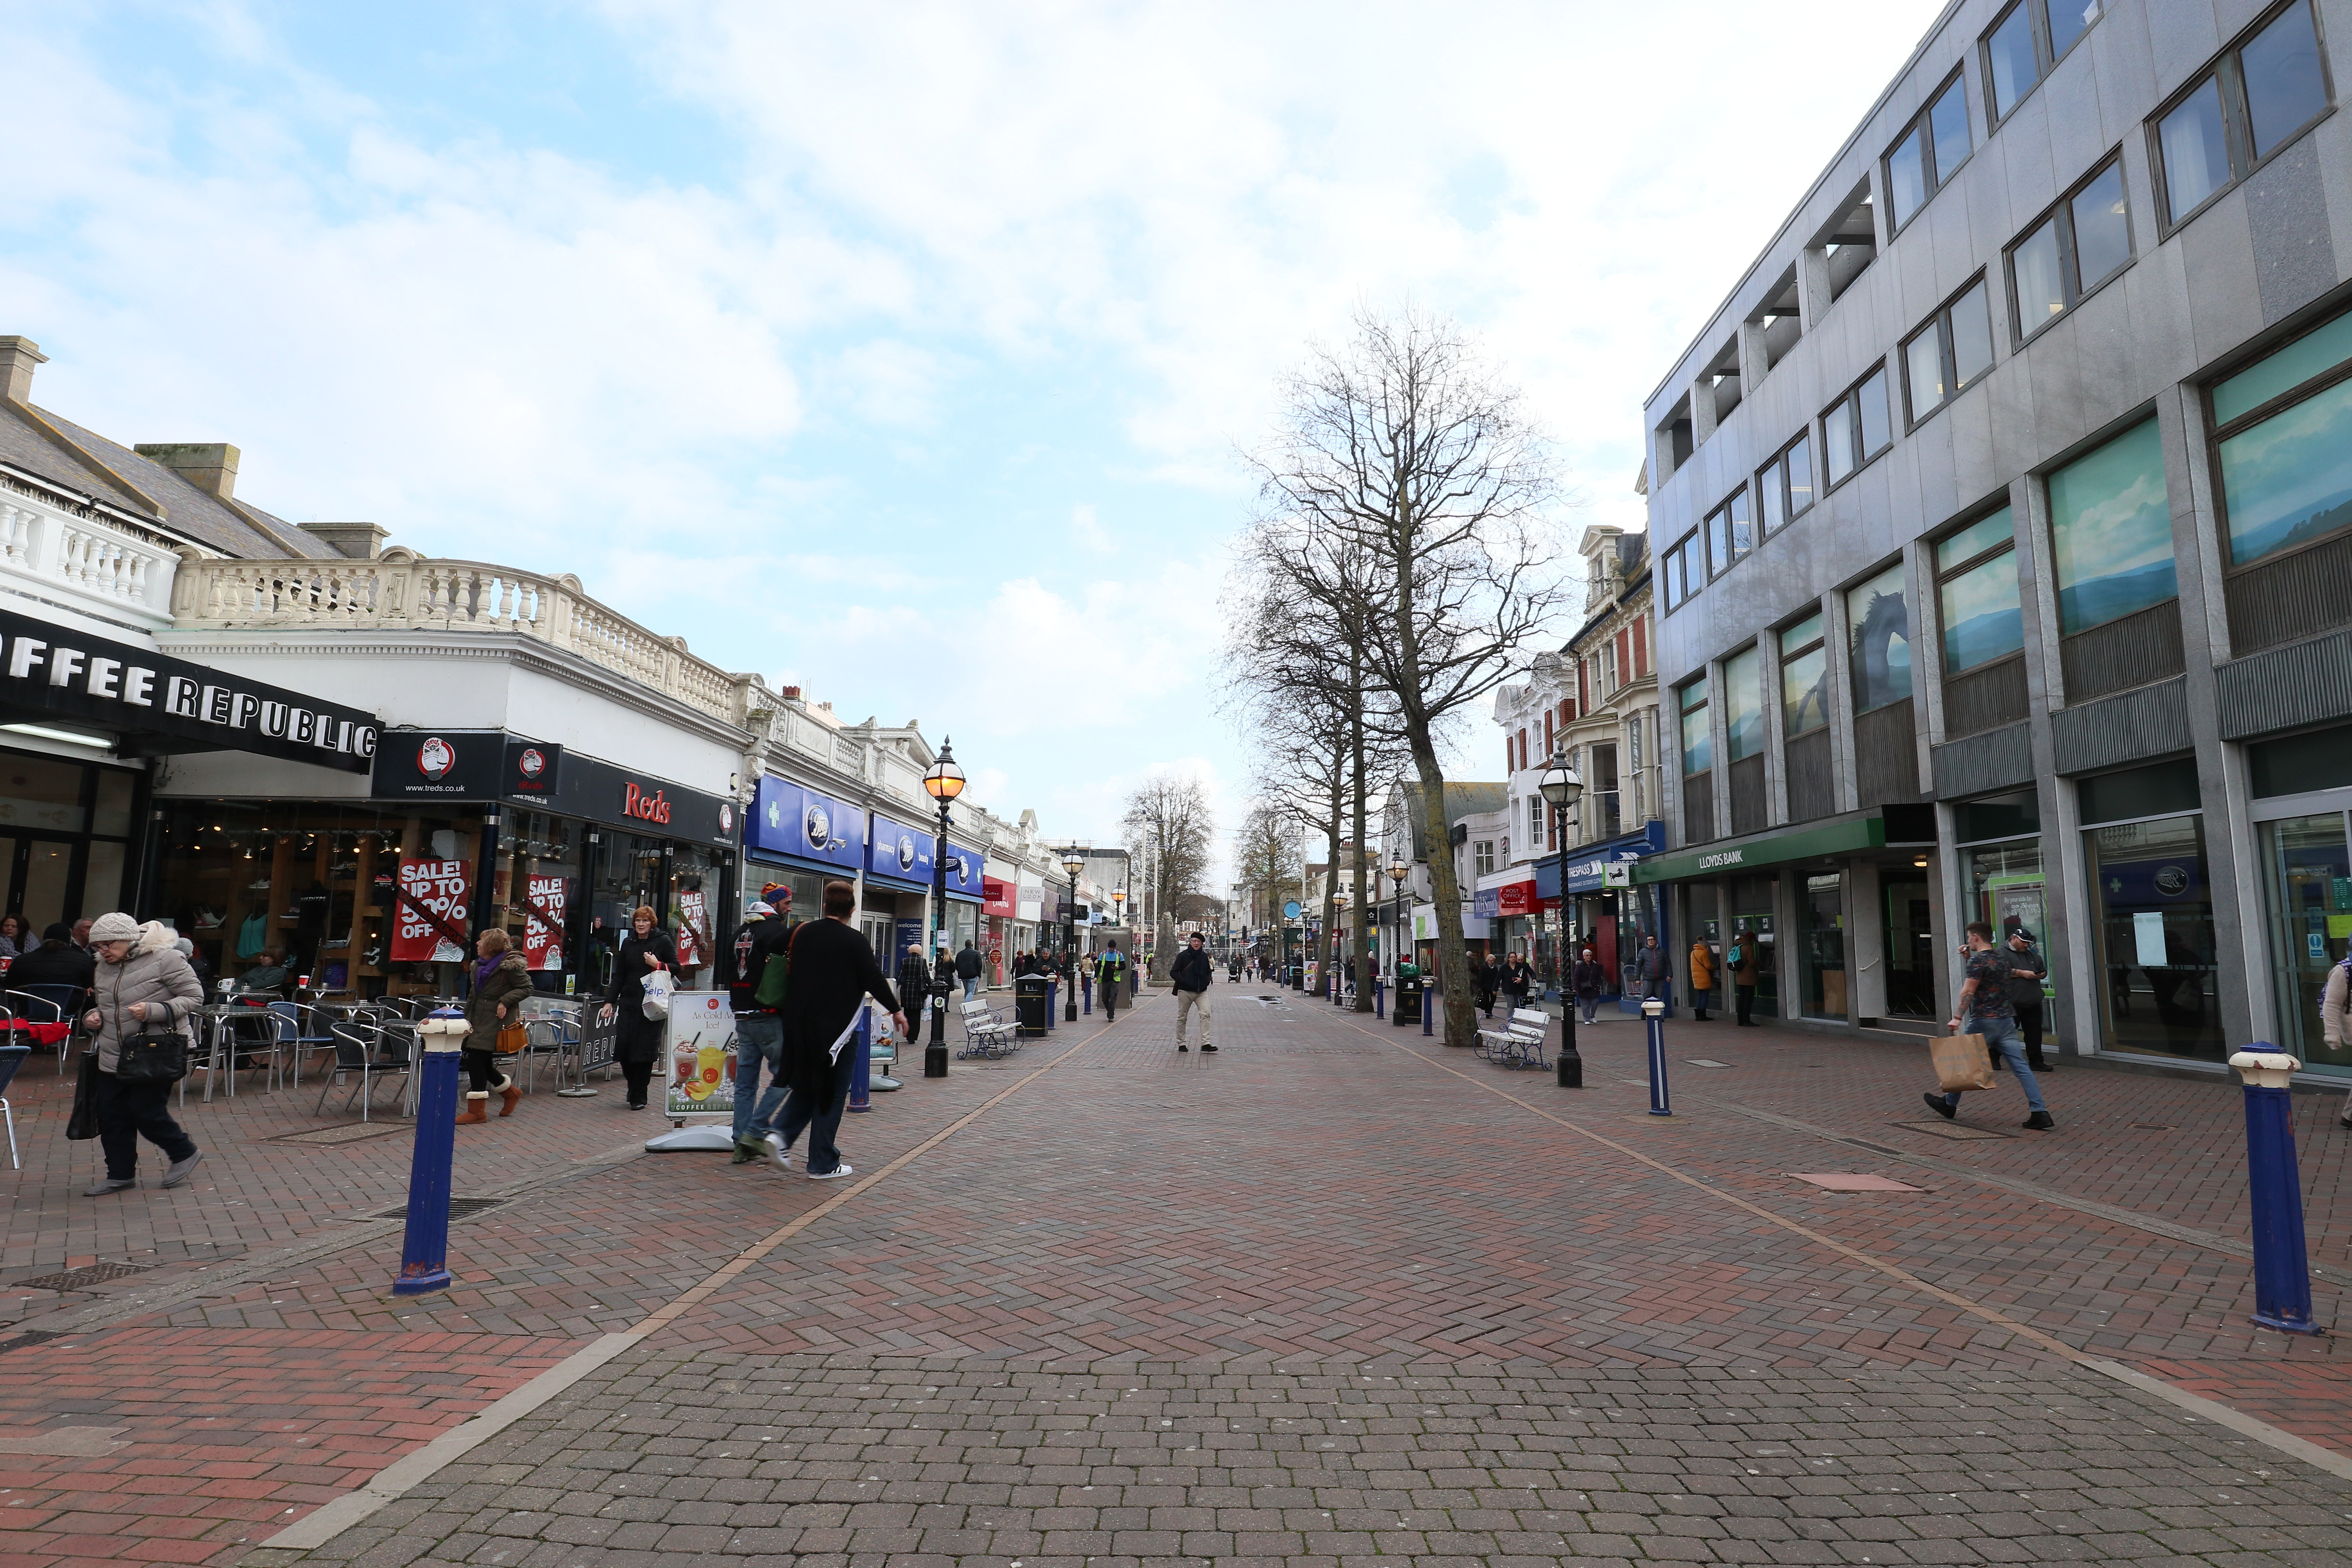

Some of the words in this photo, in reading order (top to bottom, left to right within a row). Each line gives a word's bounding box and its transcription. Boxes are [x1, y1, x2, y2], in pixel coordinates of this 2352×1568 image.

[0, 630, 156, 706] FFEE
[165, 676, 377, 758] REPUBLIC
[518, 781, 543, 789] tReds
[512, 794, 548, 805] www.treds.co.uk
[622, 782, 671, 824] Reds
[713, 836, 733, 845] www.treds.co.uk
[877, 840, 895, 856] pharmacy
[918, 852, 929, 866] beauty
[1699, 853, 1723, 869] LLOYDS
[1723, 850, 1743, 865] BANK
[401, 860, 461, 882] SALE!
[1567, 863, 1590, 878] TRESPASS
[435, 878, 465, 896] TO
[529, 878, 563, 896] SALE!
[547, 893, 564, 909] TO
[681, 892, 702, 907] SALE!
[1475, 894, 1498, 913] WHSmith
[397, 890, 417, 908] SALE
[415, 904, 435, 923] ENDS
[436, 920, 465, 944] SUNDAY
[692, 904, 703, 918] TO
[401, 923, 434, 939] OFF
[704, 1011, 722, 1019] Cold
[724, 1011, 733, 1019] As
